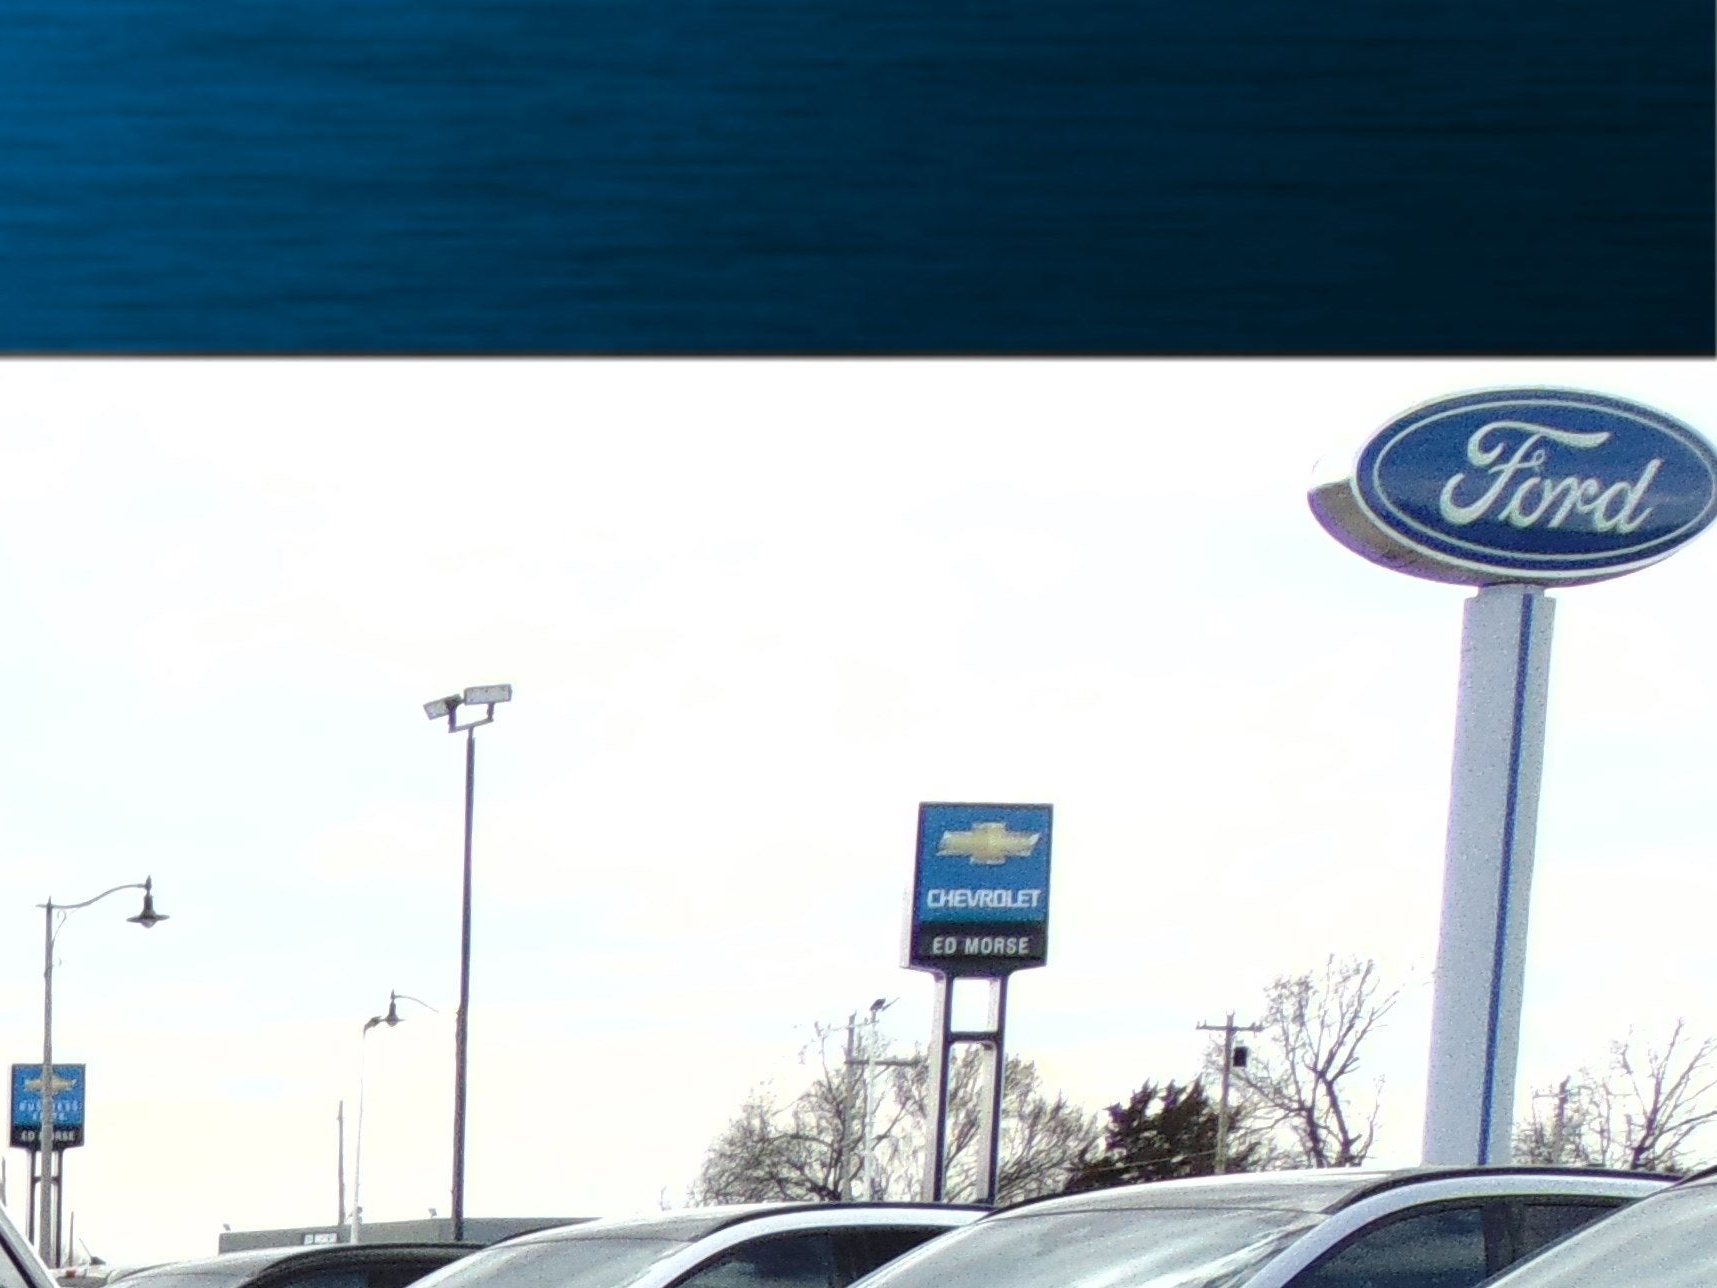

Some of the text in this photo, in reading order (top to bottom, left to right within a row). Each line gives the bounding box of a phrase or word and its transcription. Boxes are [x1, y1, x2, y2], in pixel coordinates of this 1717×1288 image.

[1439, 420, 1664, 534] Ford
[927, 888, 1042, 909] CHEVROLET
[932, 936, 1029, 956] ED MORSE
[18, 1101, 79, 1112] BUSESS
